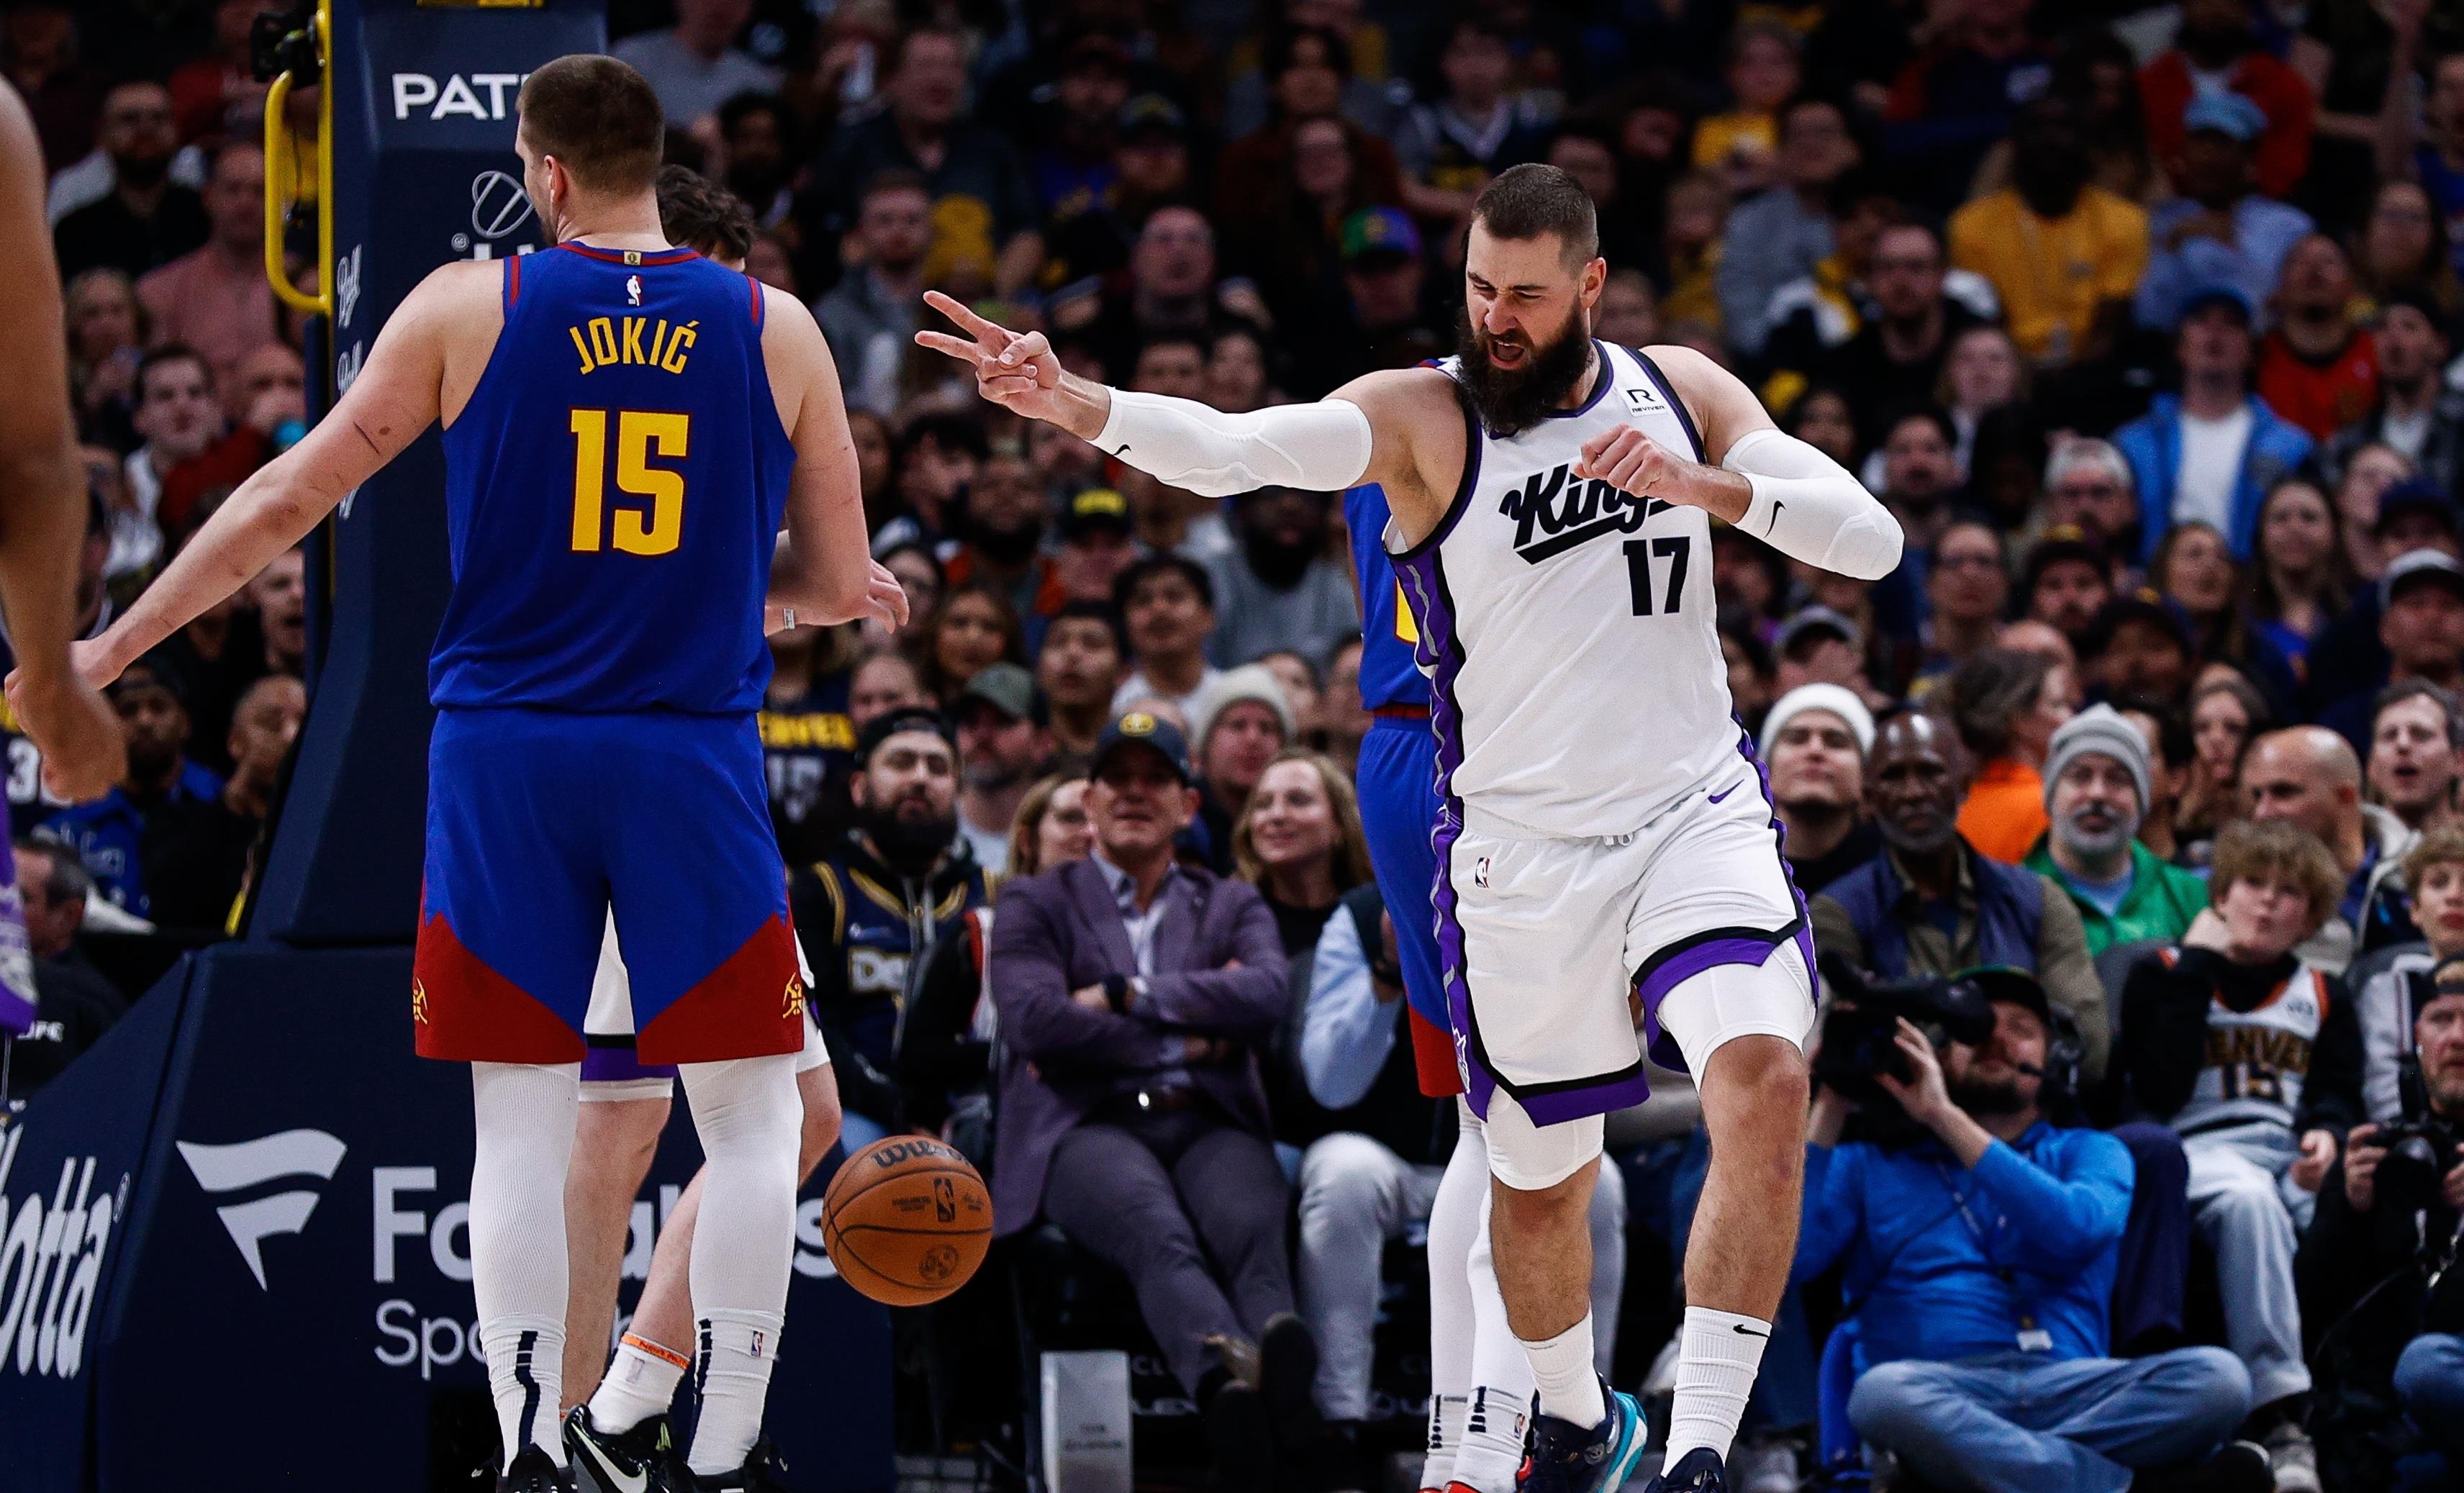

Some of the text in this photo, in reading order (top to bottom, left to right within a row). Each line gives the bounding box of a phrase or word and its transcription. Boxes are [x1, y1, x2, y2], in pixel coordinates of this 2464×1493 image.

[392, 73, 530, 120] PAT
[569, 317, 700, 375] JOKIĆ
[569, 407, 691, 558] 15
[1499, 463, 1657, 549] King
[1623, 535, 1690, 616] 17
[0, 1121, 112, 1378] otta
